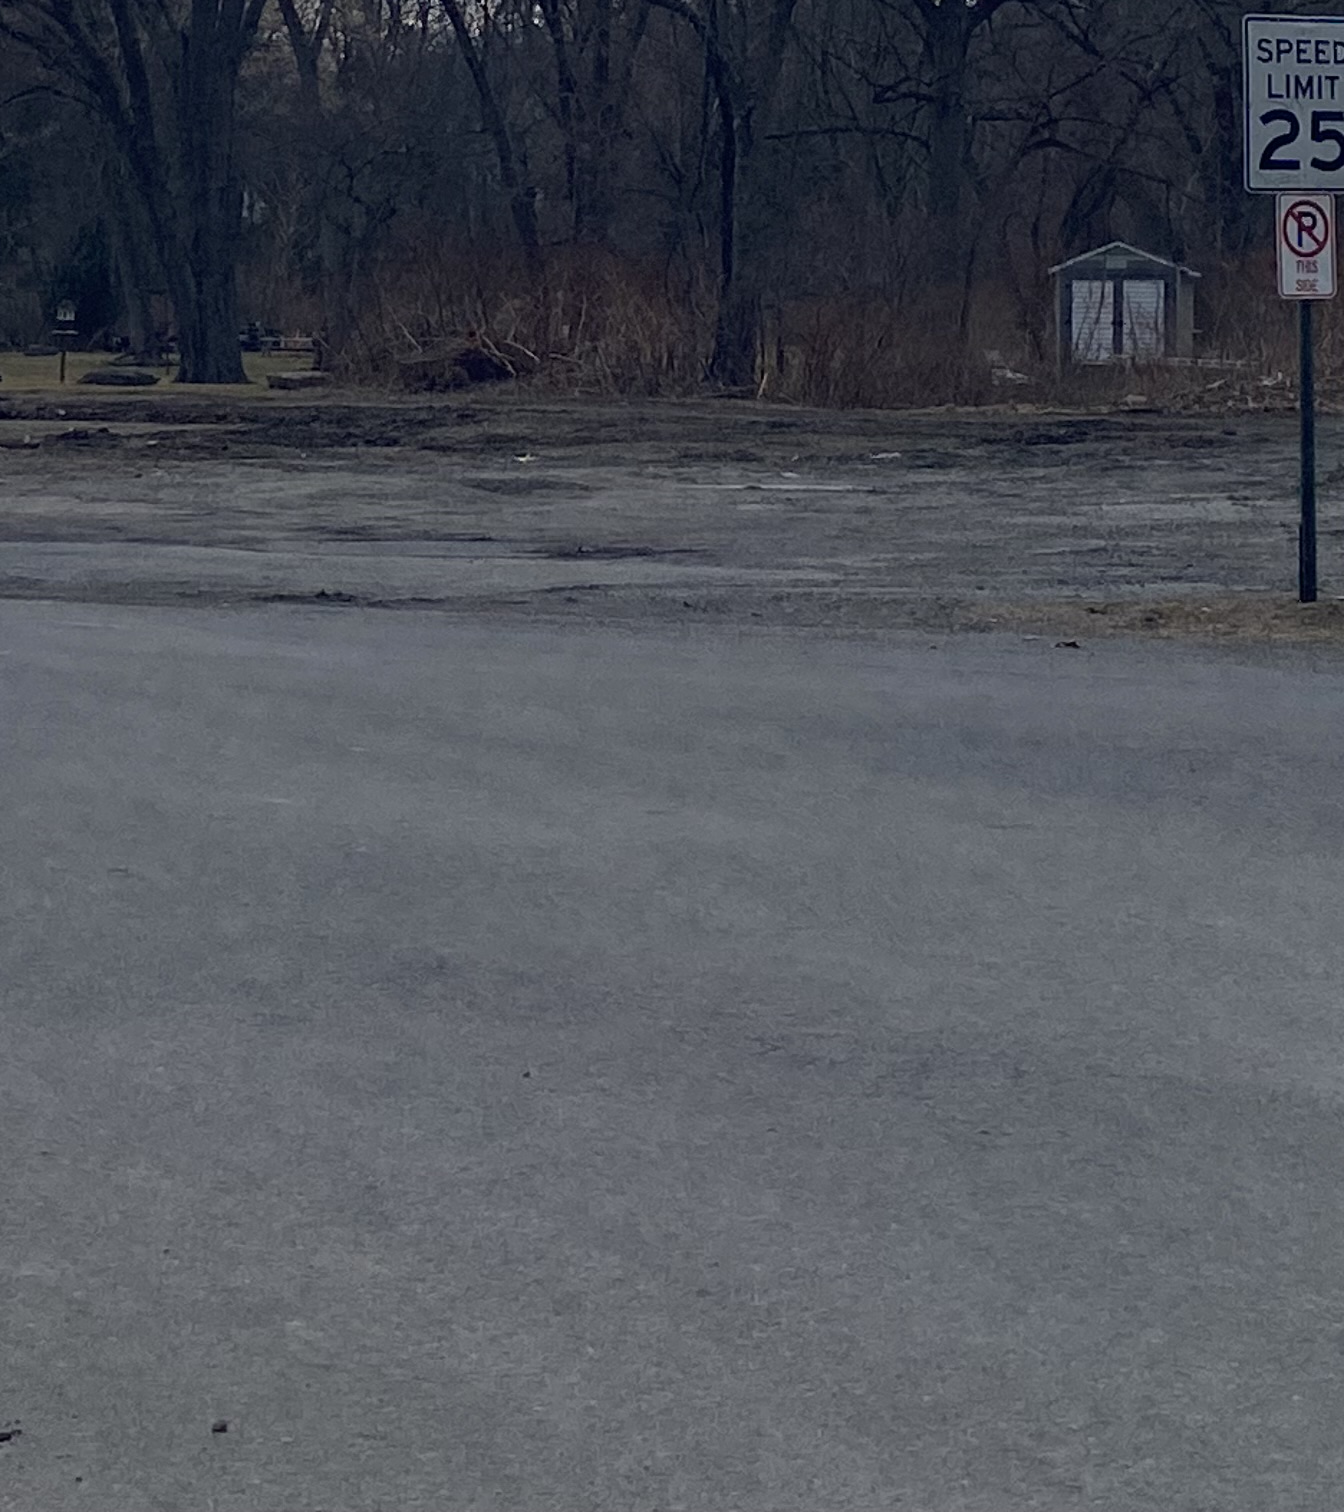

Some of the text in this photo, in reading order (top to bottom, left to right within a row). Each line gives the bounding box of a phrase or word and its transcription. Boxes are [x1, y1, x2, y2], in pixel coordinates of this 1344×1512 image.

[1267, 74, 1340, 100] LIMIT
[1296, 260, 1319, 274] THIS
[1295, 278, 1319, 292] SIDE
